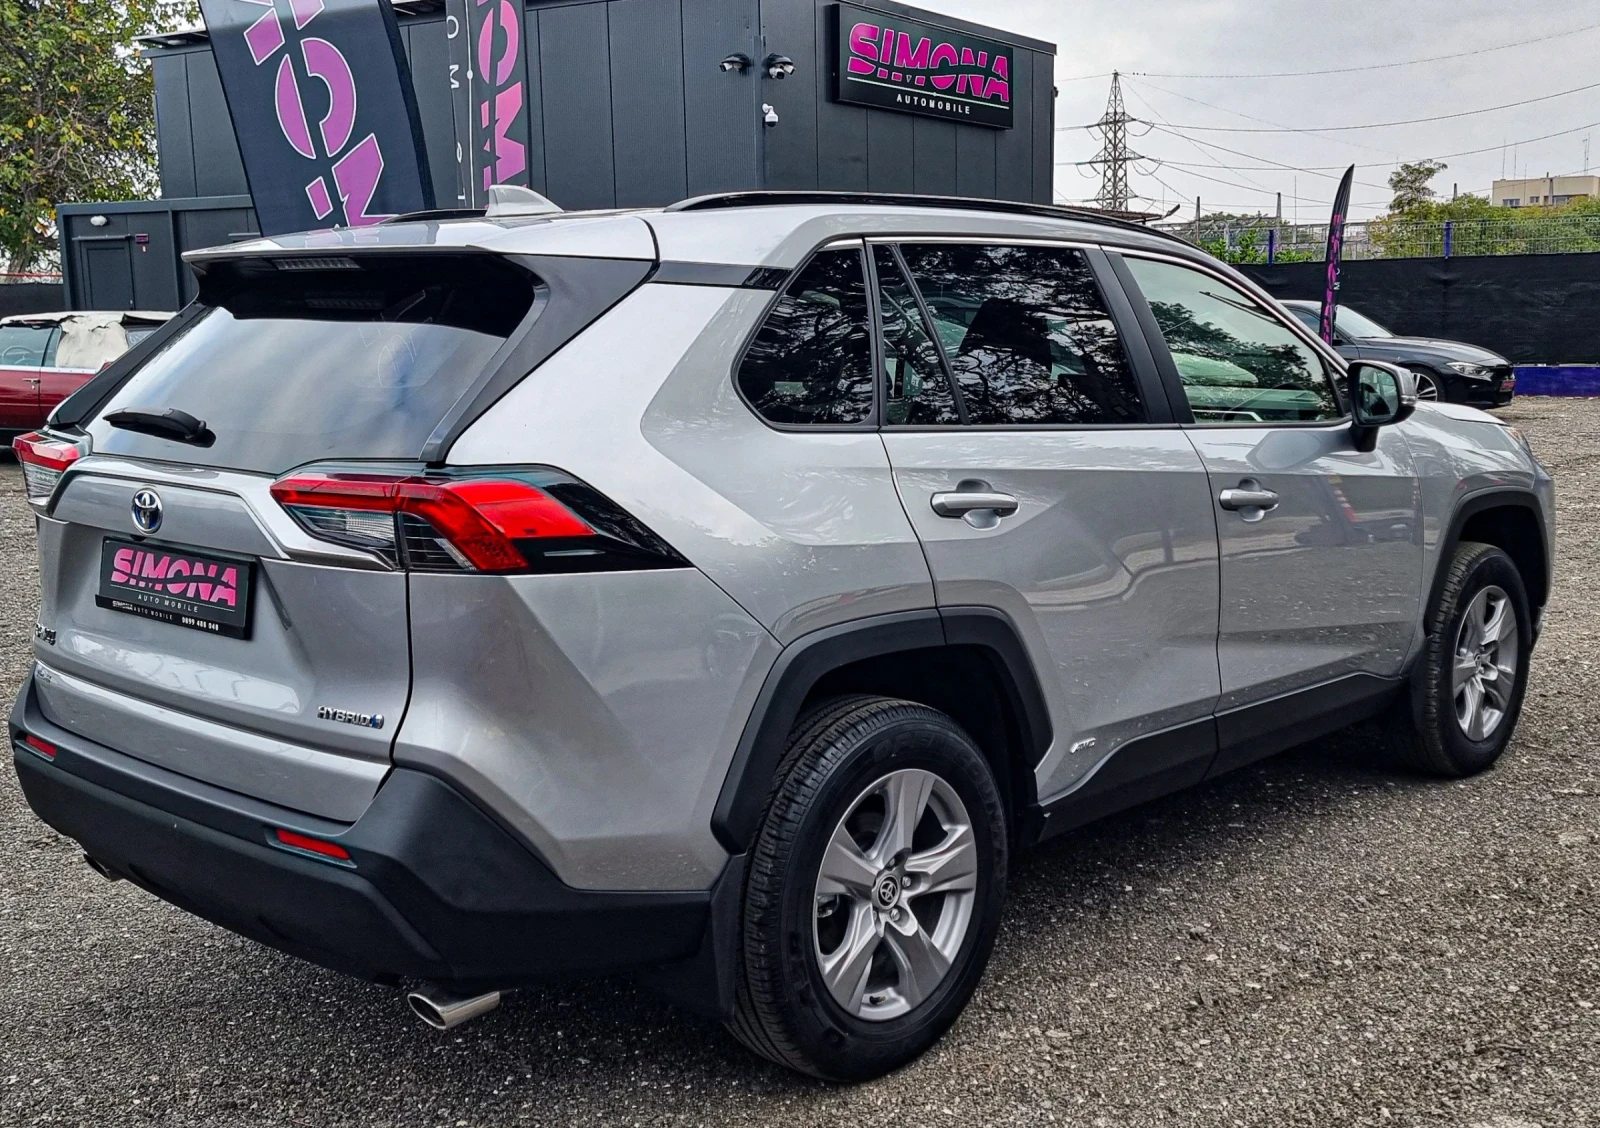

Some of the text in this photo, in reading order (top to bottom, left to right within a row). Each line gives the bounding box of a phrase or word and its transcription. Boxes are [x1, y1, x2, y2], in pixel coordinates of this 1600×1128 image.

[847, 22, 1009, 102] SIMONA
[896, 93, 971, 115] AUTOMOBILE
[111, 548, 236, 607] SIMONA
[137, 593, 199, 613] AUTO MOBILE
[317, 704, 372, 728] HYBRID
